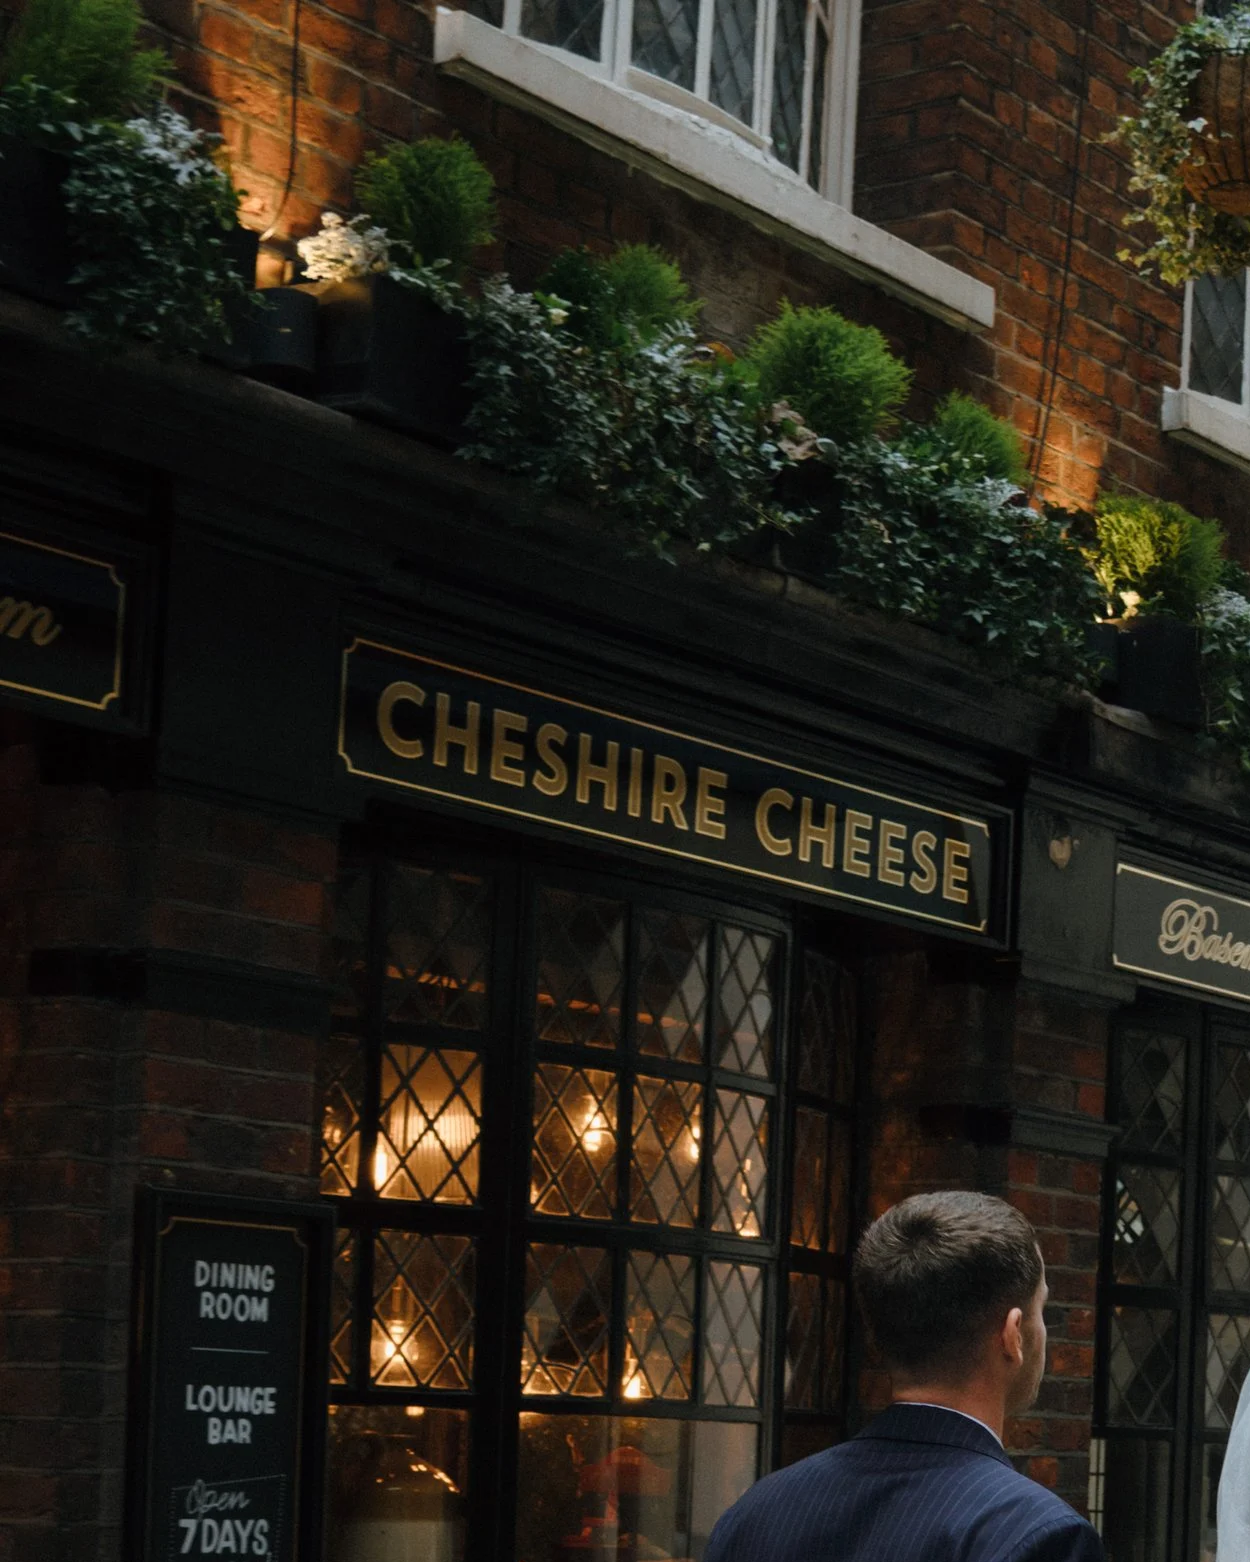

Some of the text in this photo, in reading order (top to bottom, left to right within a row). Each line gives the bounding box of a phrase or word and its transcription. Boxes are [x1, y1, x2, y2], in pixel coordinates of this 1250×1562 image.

[376, 680, 971, 904] CHESHIRE CHEESE
[194, 1260, 276, 1293] DINING
[200, 1291, 270, 1323] ROOM
[185, 1384, 278, 1416] LOUNGE
[207, 1417, 254, 1446] BAR
[186, 1479, 253, 1519] Open
[178, 1518, 270, 1556] 7 DAYS
